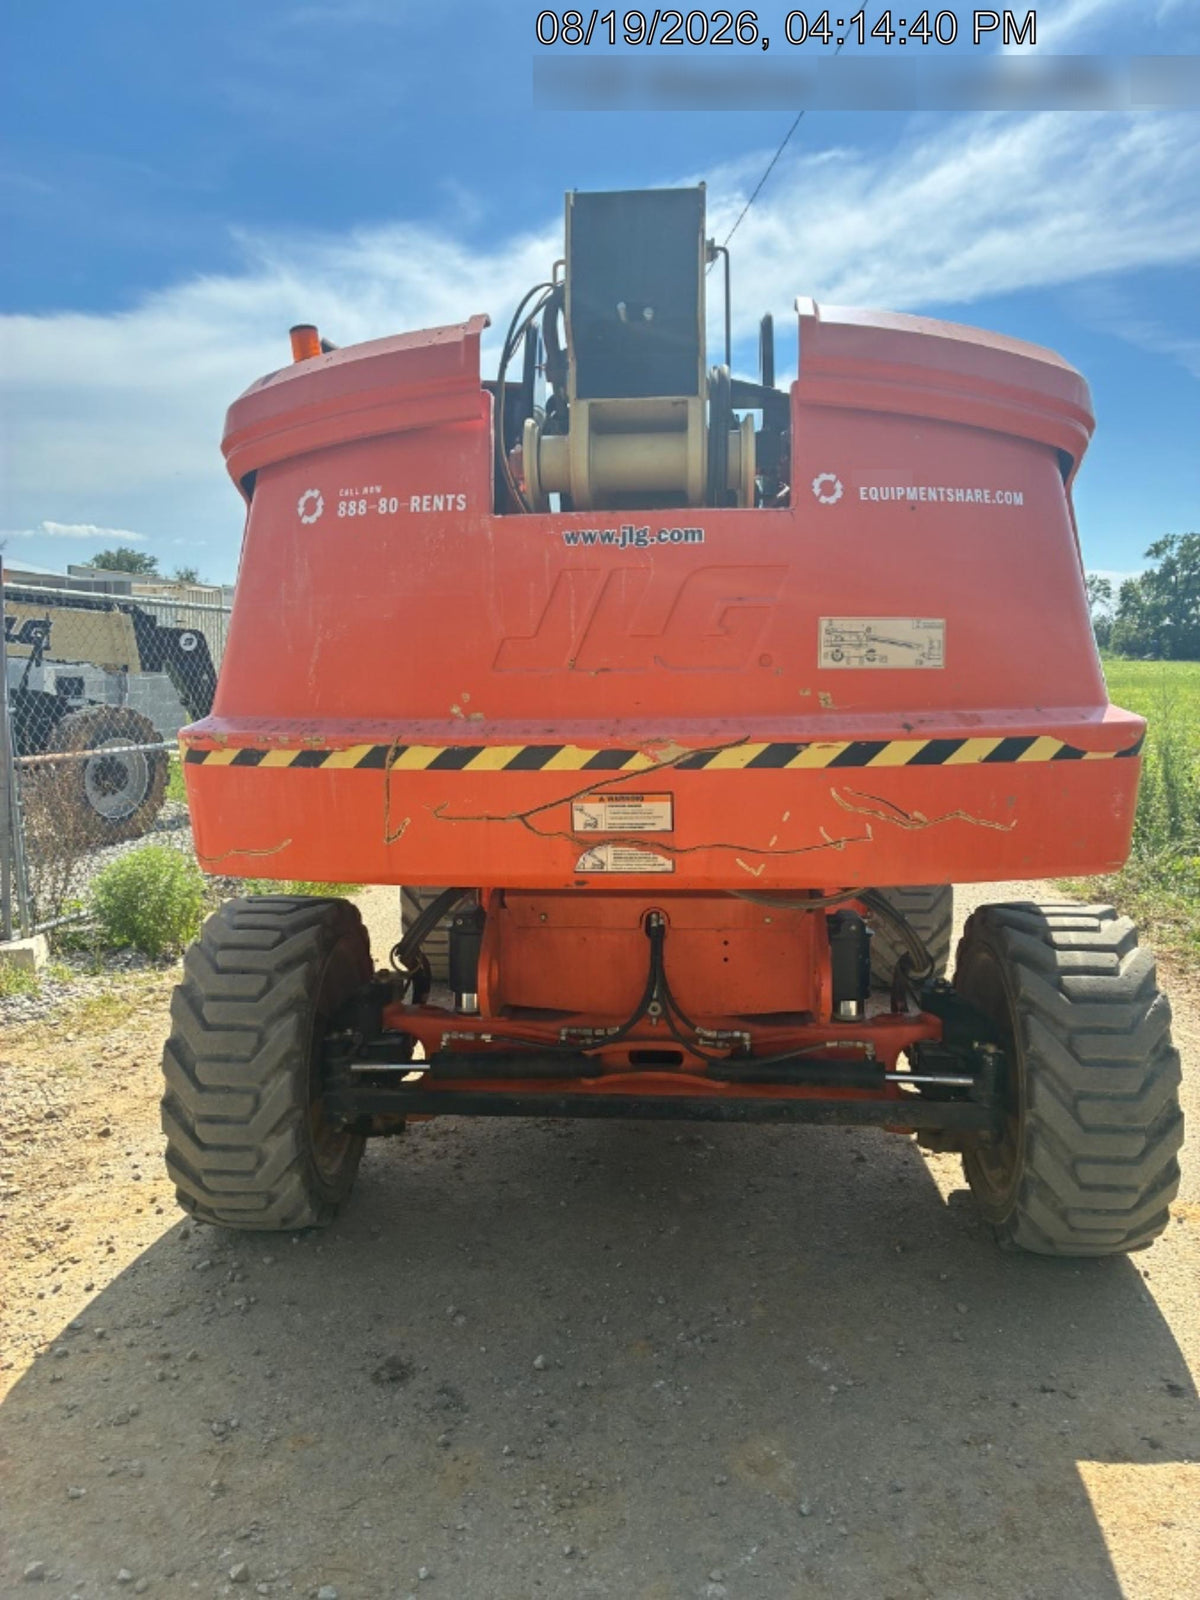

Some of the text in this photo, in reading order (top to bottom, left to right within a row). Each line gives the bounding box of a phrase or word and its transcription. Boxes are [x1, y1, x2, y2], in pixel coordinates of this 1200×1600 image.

[859, 486, 1024, 506] EQUIPMENTSHARE.COM
[563, 525, 705, 548] www.jlg.com
[492, 565, 791, 672] JLG
